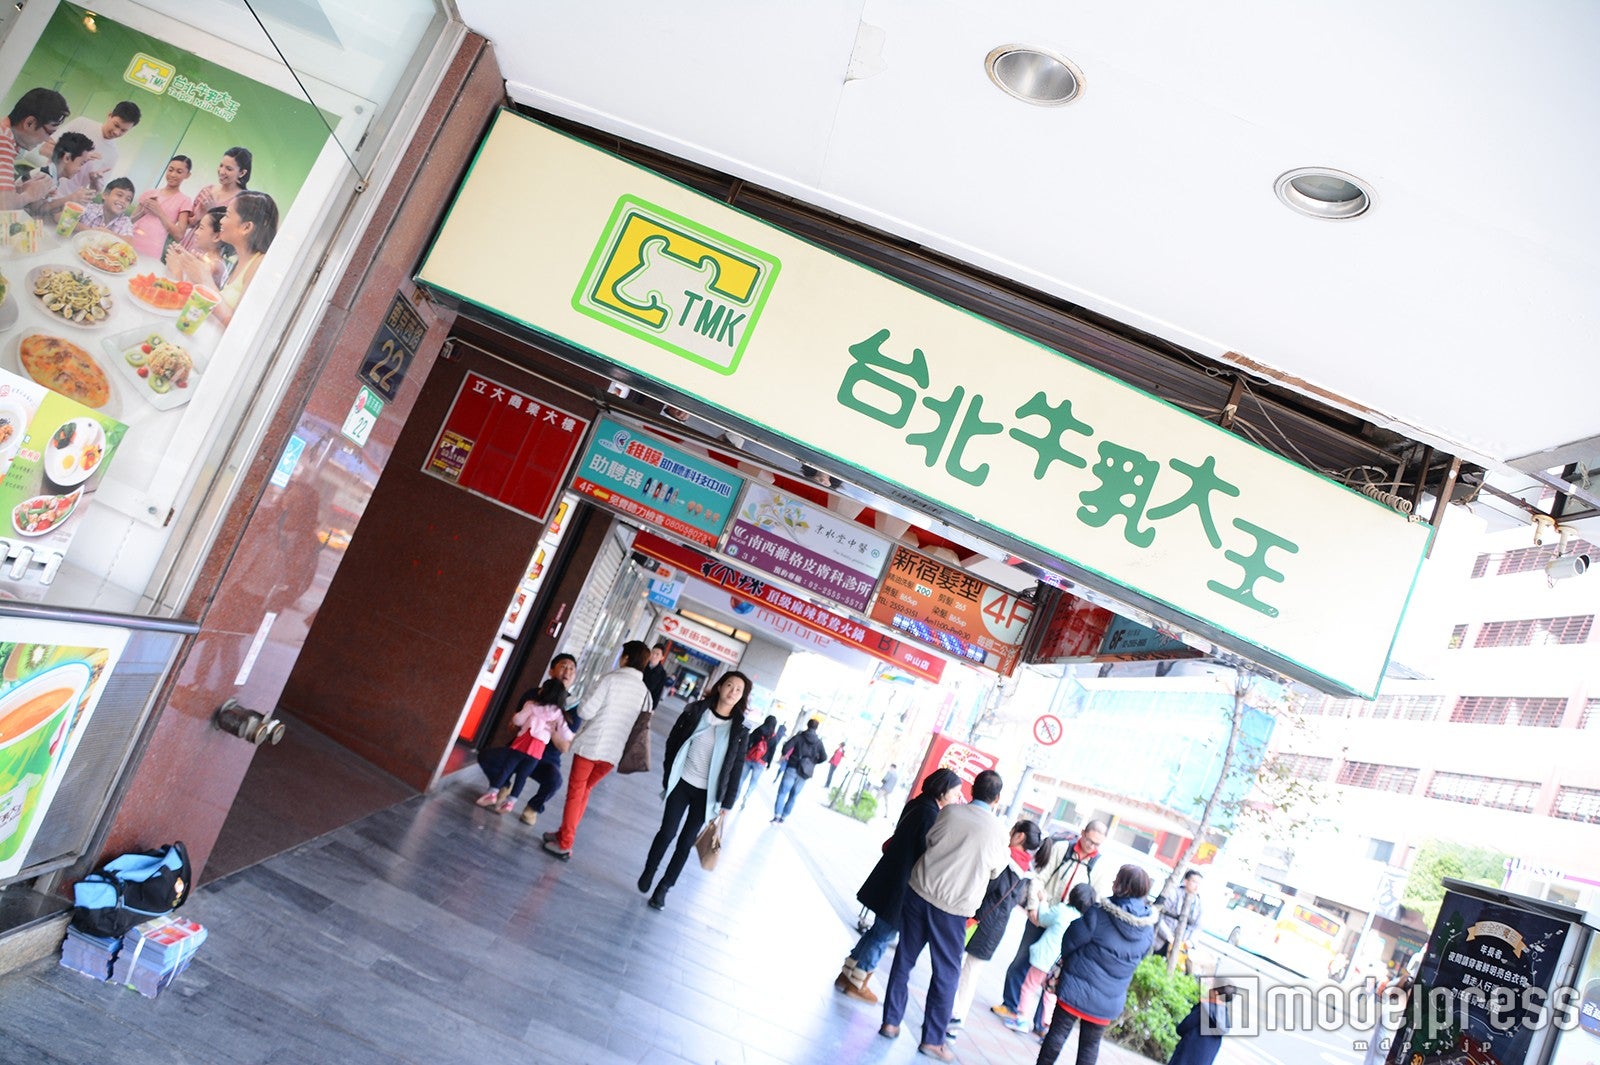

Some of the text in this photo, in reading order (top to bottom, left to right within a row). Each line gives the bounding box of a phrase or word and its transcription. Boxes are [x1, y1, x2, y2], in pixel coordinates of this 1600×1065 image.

[681, 289, 747, 346] TMK
[369, 339, 405, 392] 22
[352, 416, 368, 438] 22
[472, 380, 577, 433] 立大商業大樓
[578, 481, 594, 494] 4F
[588, 455, 645, 489] 助聽器
[836, 329, 1299, 618] 台北牛乳大王
[747, 532, 872, 598] 南西維格皮膚科診所
[894, 548, 985, 603] 新宿髮型
[918, 585, 932, 597] 200
[982, 594, 1033, 629] 4F
[766, 590, 865, 642] 頂級麻辣鴛鴦火鍋
[904, 652, 931, 670] 中山店
[1480, 944, 1503, 959] 年長者
